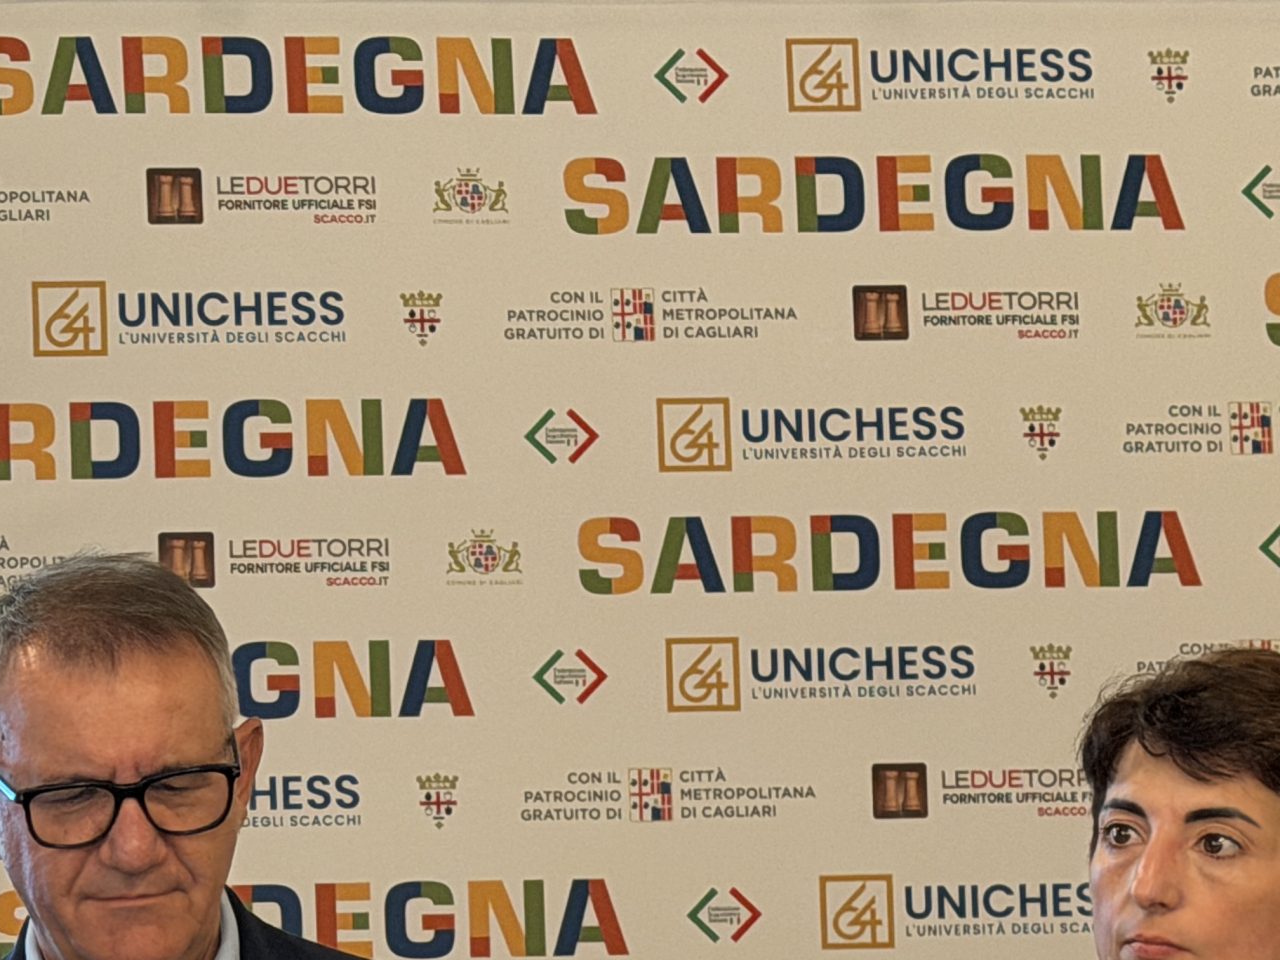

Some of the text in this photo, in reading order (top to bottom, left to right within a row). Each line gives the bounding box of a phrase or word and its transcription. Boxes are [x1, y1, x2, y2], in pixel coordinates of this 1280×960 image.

[871, 49, 1092, 83] UNICHESS
[872, 86, 1094, 100] L'UNIVERSITÀ DEGLI SCACCHI
[217, 176, 376, 195] LEDUETORRI
[563, 154, 1185, 234] SARDEGNA
[218, 199, 376, 210] FORNITORE UFFICIALE FSI
[314, 214, 376, 224] SCACCO.IT
[550, 291, 603, 303] CON IL
[662, 287, 708, 302] CITTÀ
[922, 292, 1078, 311] LEDUETORRI
[119, 291, 344, 327] UNICHESS
[508, 309, 604, 322] PATROCINIO
[663, 307, 797, 320] METROPOLITANA
[924, 314, 1079, 326] FORNITORE UFFICIALE FSI
[119, 330, 345, 344] L'UNIVERSITÀ DEGLI SCACCHI
[504, 327, 604, 340] GRATUITO DI
[663, 326, 758, 338] DI CAGLIARI
[1018, 329, 1078, 339] SCACCO.IT
[1168, 405, 1221, 417] CON IL
[742, 407, 964, 443] UNICHESS
[1126, 423, 1222, 435] PATROCINIO
[743, 445, 966, 460] L'UNIVERSITÀ DEGLI SCACCHI
[1123, 440, 1223, 453] GRATUITO DI
[229, 538, 389, 558] LEDUETORRI
[577, 510, 1202, 595] SARDEGNA
[230, 561, 389, 574] FORNITORE UFFICIALE FSI
[326, 576, 389, 586] SCACCO.IT
[751, 645, 974, 682] UNICHESS
[752, 684, 976, 699] L'UNIVERSITÀ DEGLI SCACCHI
[568, 772, 621, 784] CON IL
[679, 767, 726, 783] CITTÀ
[524, 790, 621, 803] PATROCINIO
[680, 786, 816, 800] METROPOLITANA
[943, 792, 1012, 804] FORNITORE
[1016, 792, 1078, 803] UFFICIALE
[521, 808, 622, 821] GRATUITO DI
[681, 805, 776, 818] DI CAGLIARI
[290, 815, 361, 826] SCACCHI
[905, 882, 1093, 919] UNICHES
[906, 922, 1005, 937] L'UNIVERSITÀ
[1012, 923, 1054, 935] DEGLI
